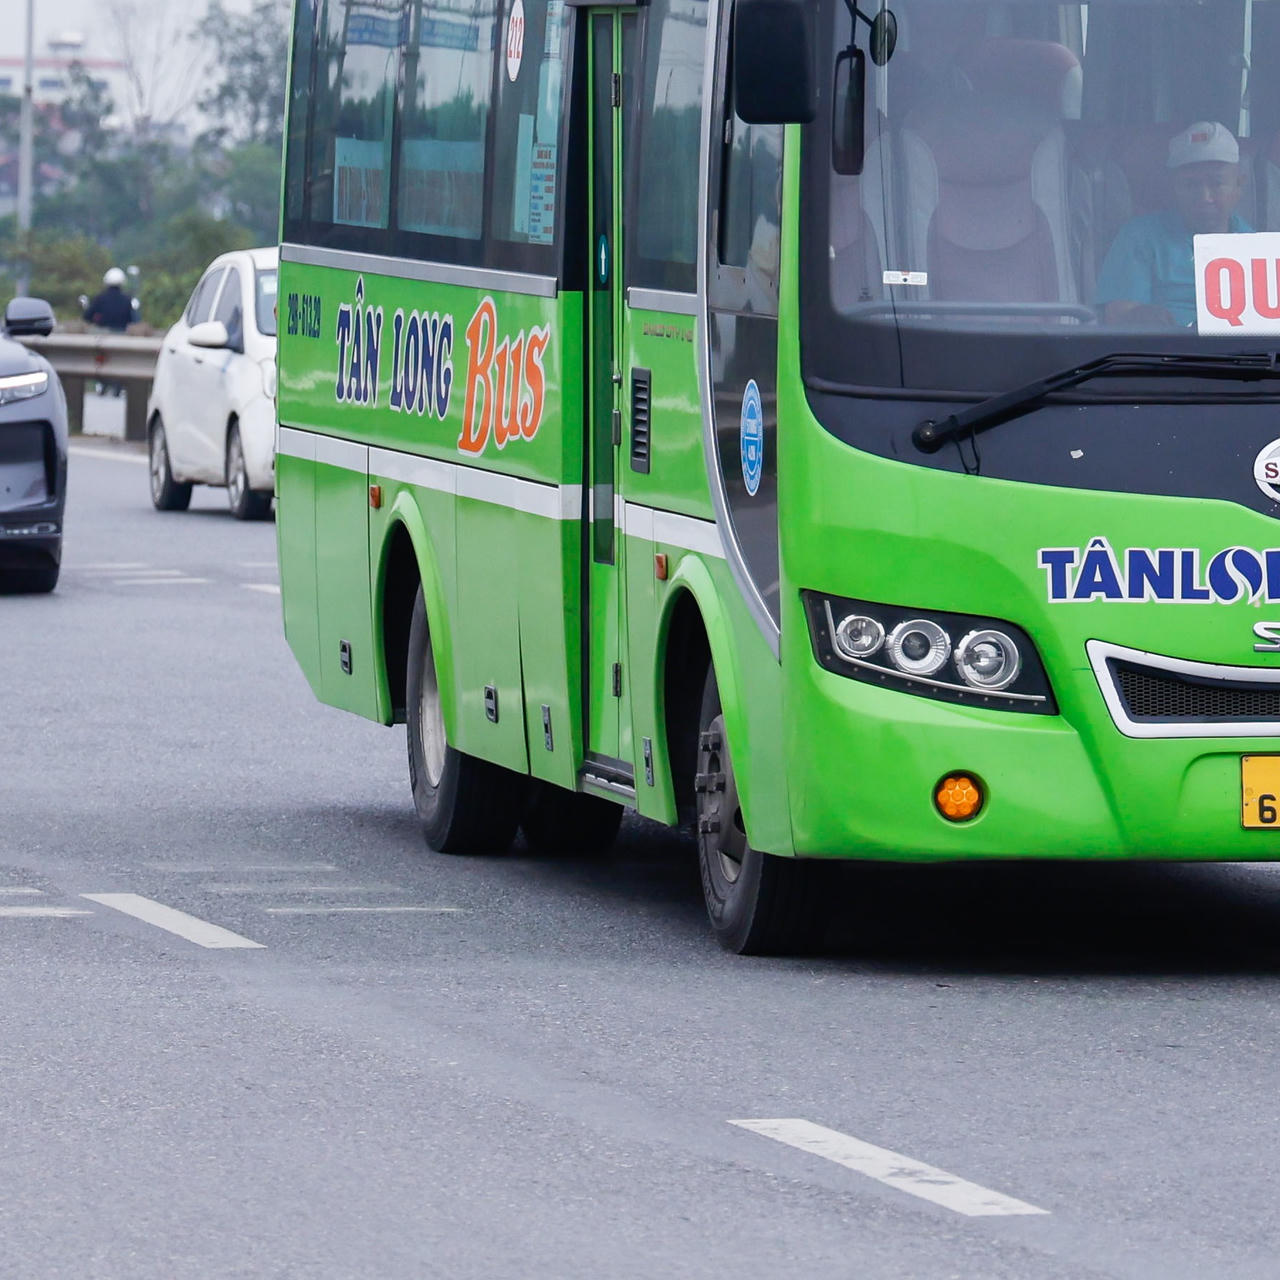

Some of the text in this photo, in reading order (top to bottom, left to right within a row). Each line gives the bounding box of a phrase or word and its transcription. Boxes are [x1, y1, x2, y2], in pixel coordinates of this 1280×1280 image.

[507, 15, 524, 60] 212
[336, 274, 550, 457] TÂN LONG Bus
